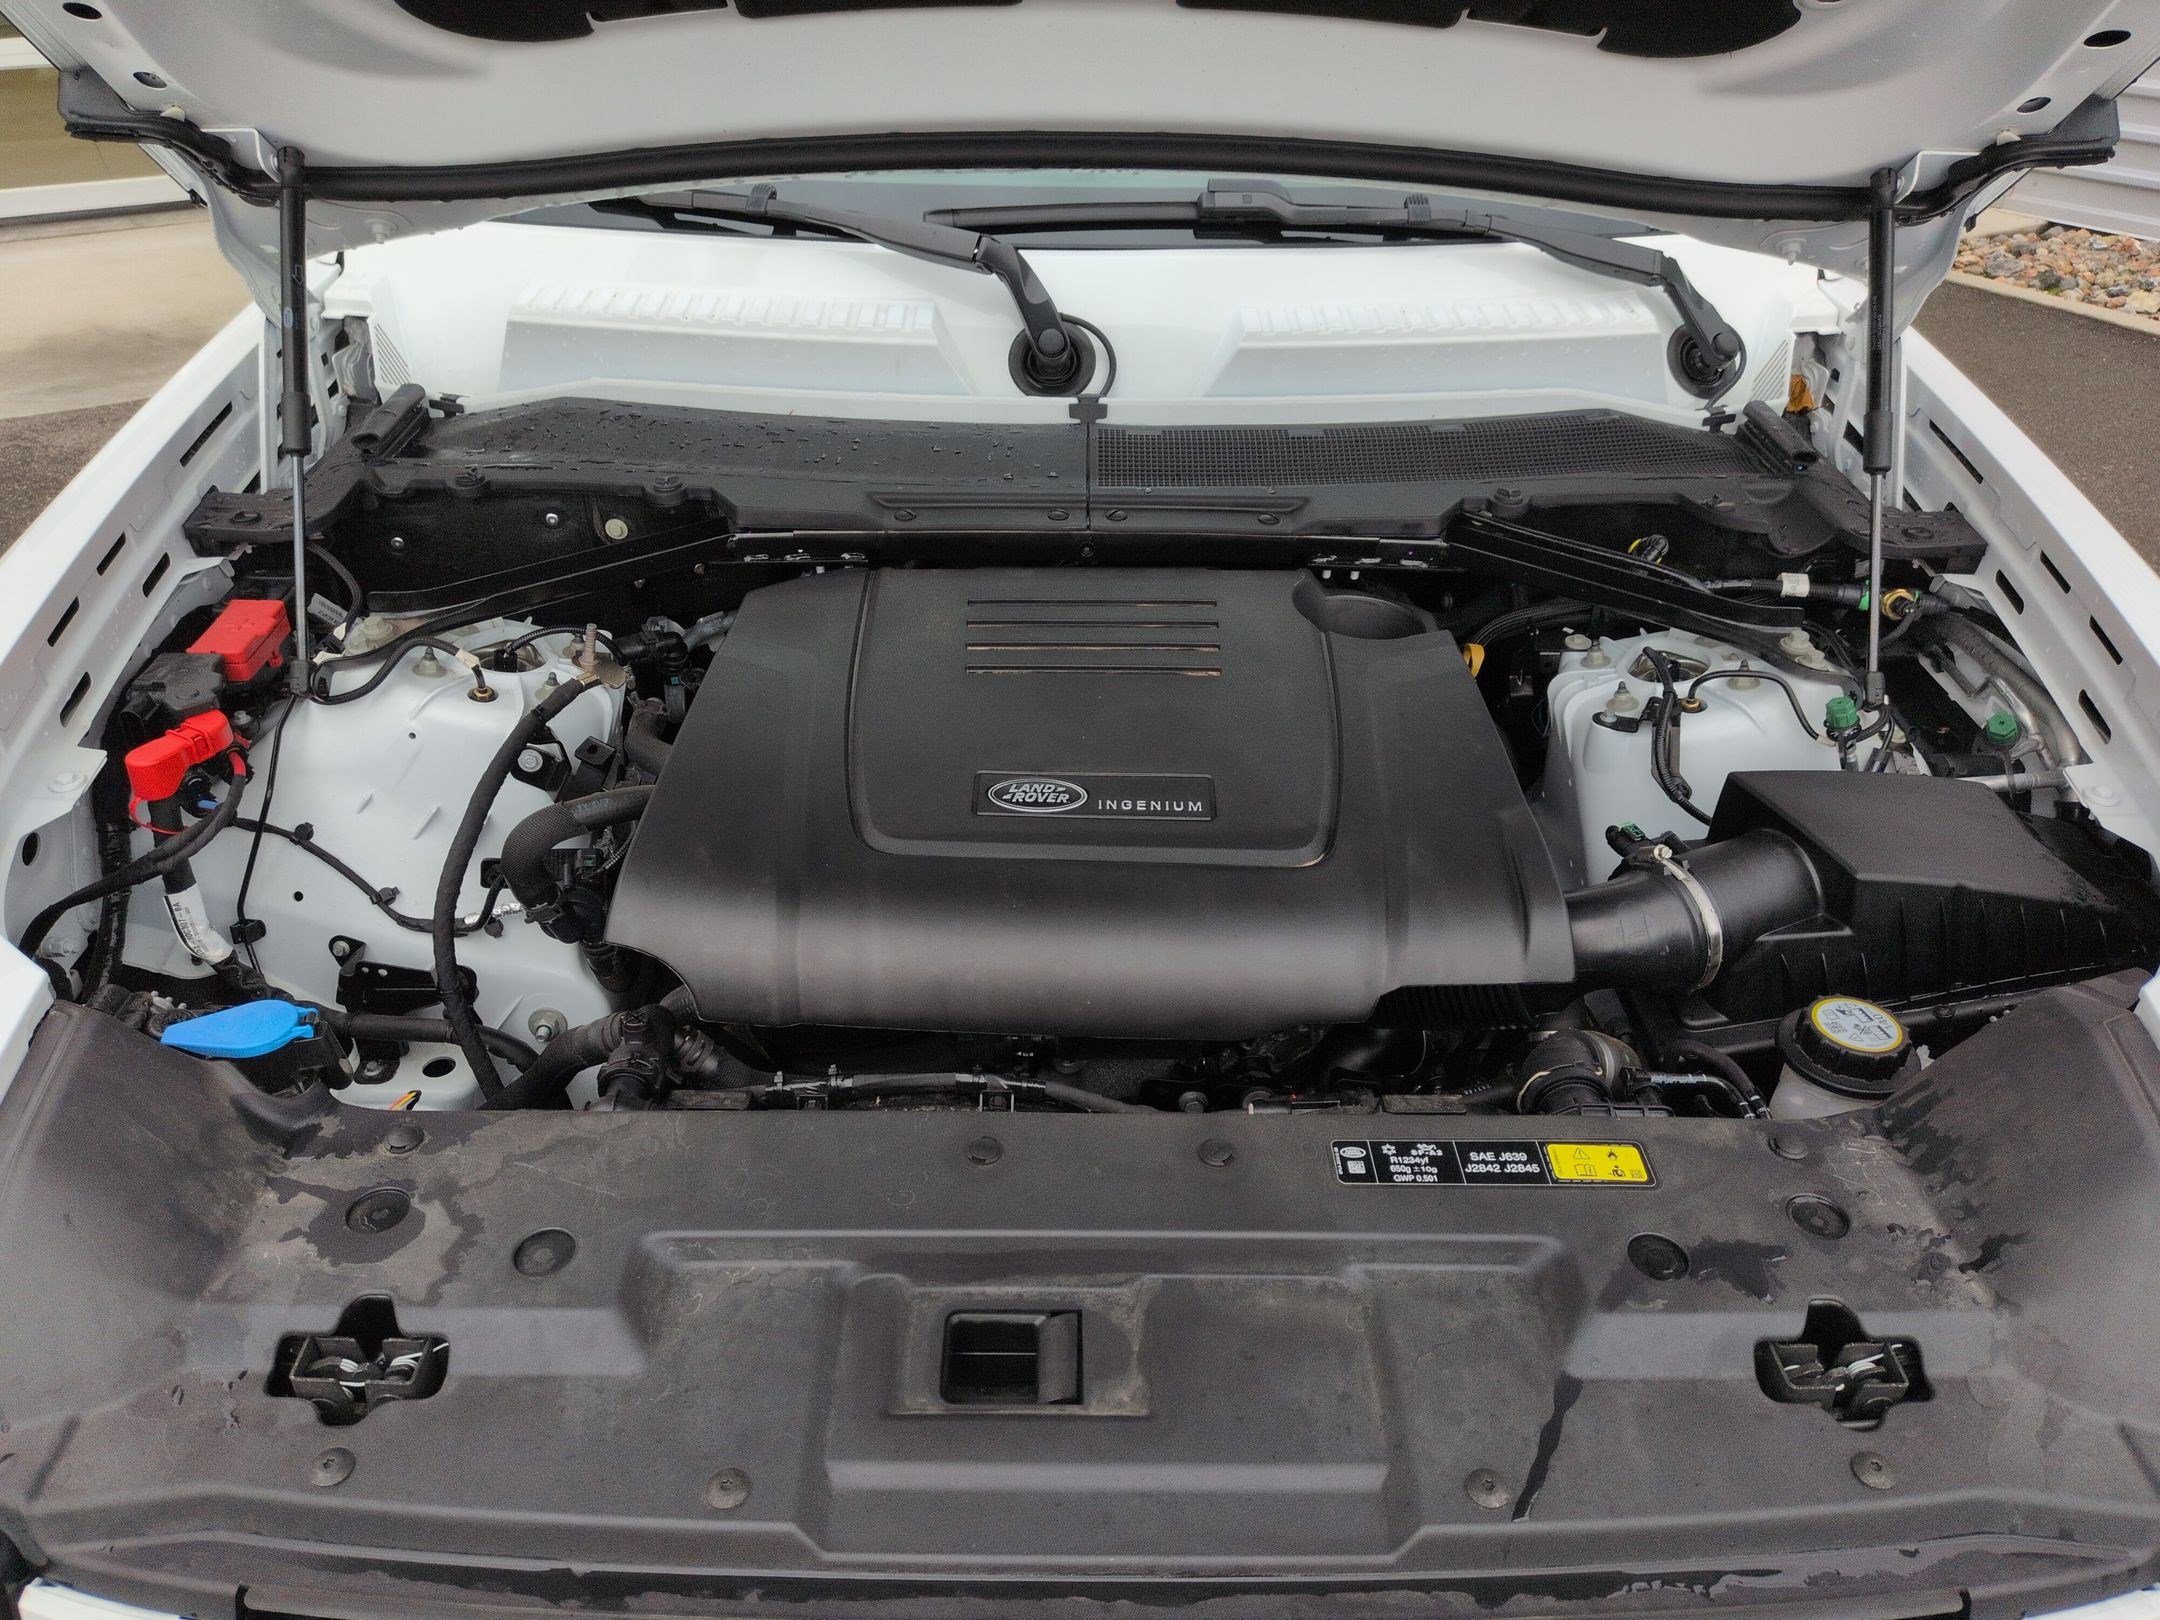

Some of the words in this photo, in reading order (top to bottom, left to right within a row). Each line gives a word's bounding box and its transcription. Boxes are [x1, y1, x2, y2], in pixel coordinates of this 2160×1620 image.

[1008, 783, 1056, 793] LAND
[1011, 792, 1070, 803] ROVER
[1097, 799, 1203, 812] INGENIUM
[1389, 1156, 1429, 1165] R1234yf
[1469, 1151, 1497, 1161] SAE
[1498, 1152, 1528, 1162] J639
[1389, 1164, 1412, 1173] 650g
[1464, 1163, 1502, 1173] J2842
[1503, 1163, 1540, 1173] J2845
[1393, 1174, 1415, 1182] GWP
[1415, 1174, 1438, 1182] 0.501
